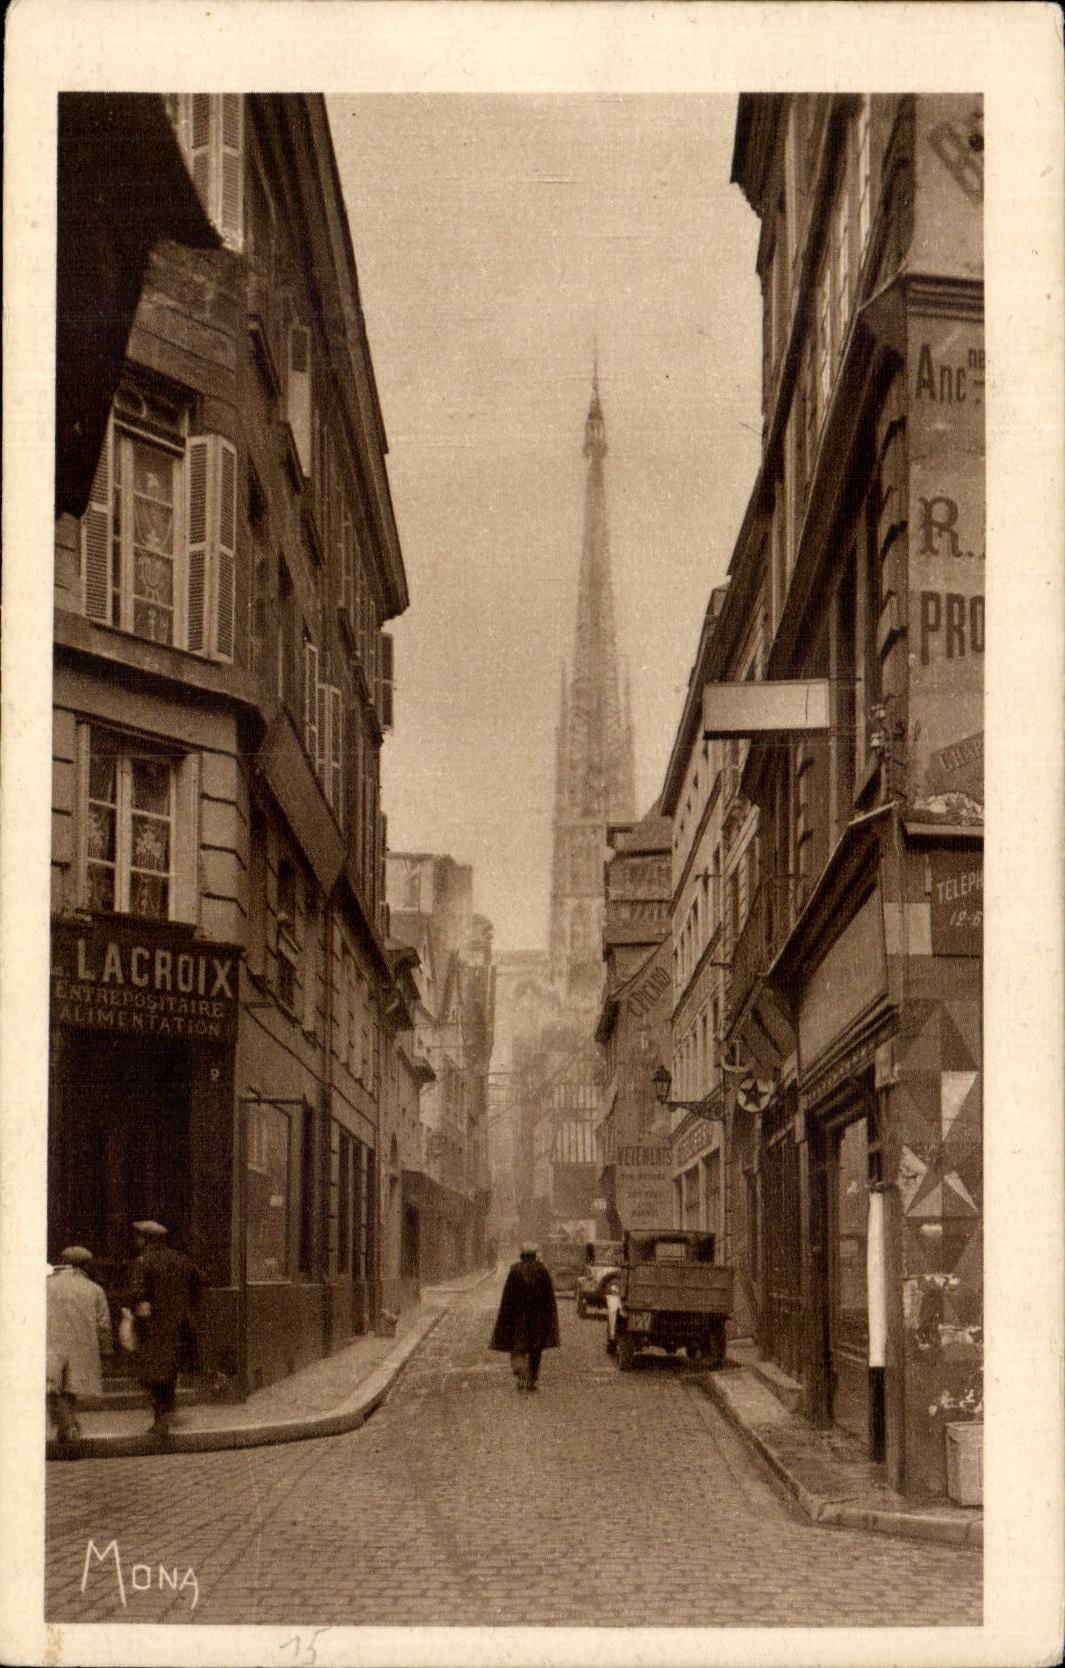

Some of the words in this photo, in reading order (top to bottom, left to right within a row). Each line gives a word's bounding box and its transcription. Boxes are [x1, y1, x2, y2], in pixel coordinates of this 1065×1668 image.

[921, 591, 984, 666] PRO
[77, 938, 233, 999] LACROIX
[56, 979, 224, 1018] ENTREPOSITAIRE
[59, 1004, 220, 1037] ALIMENTATION
